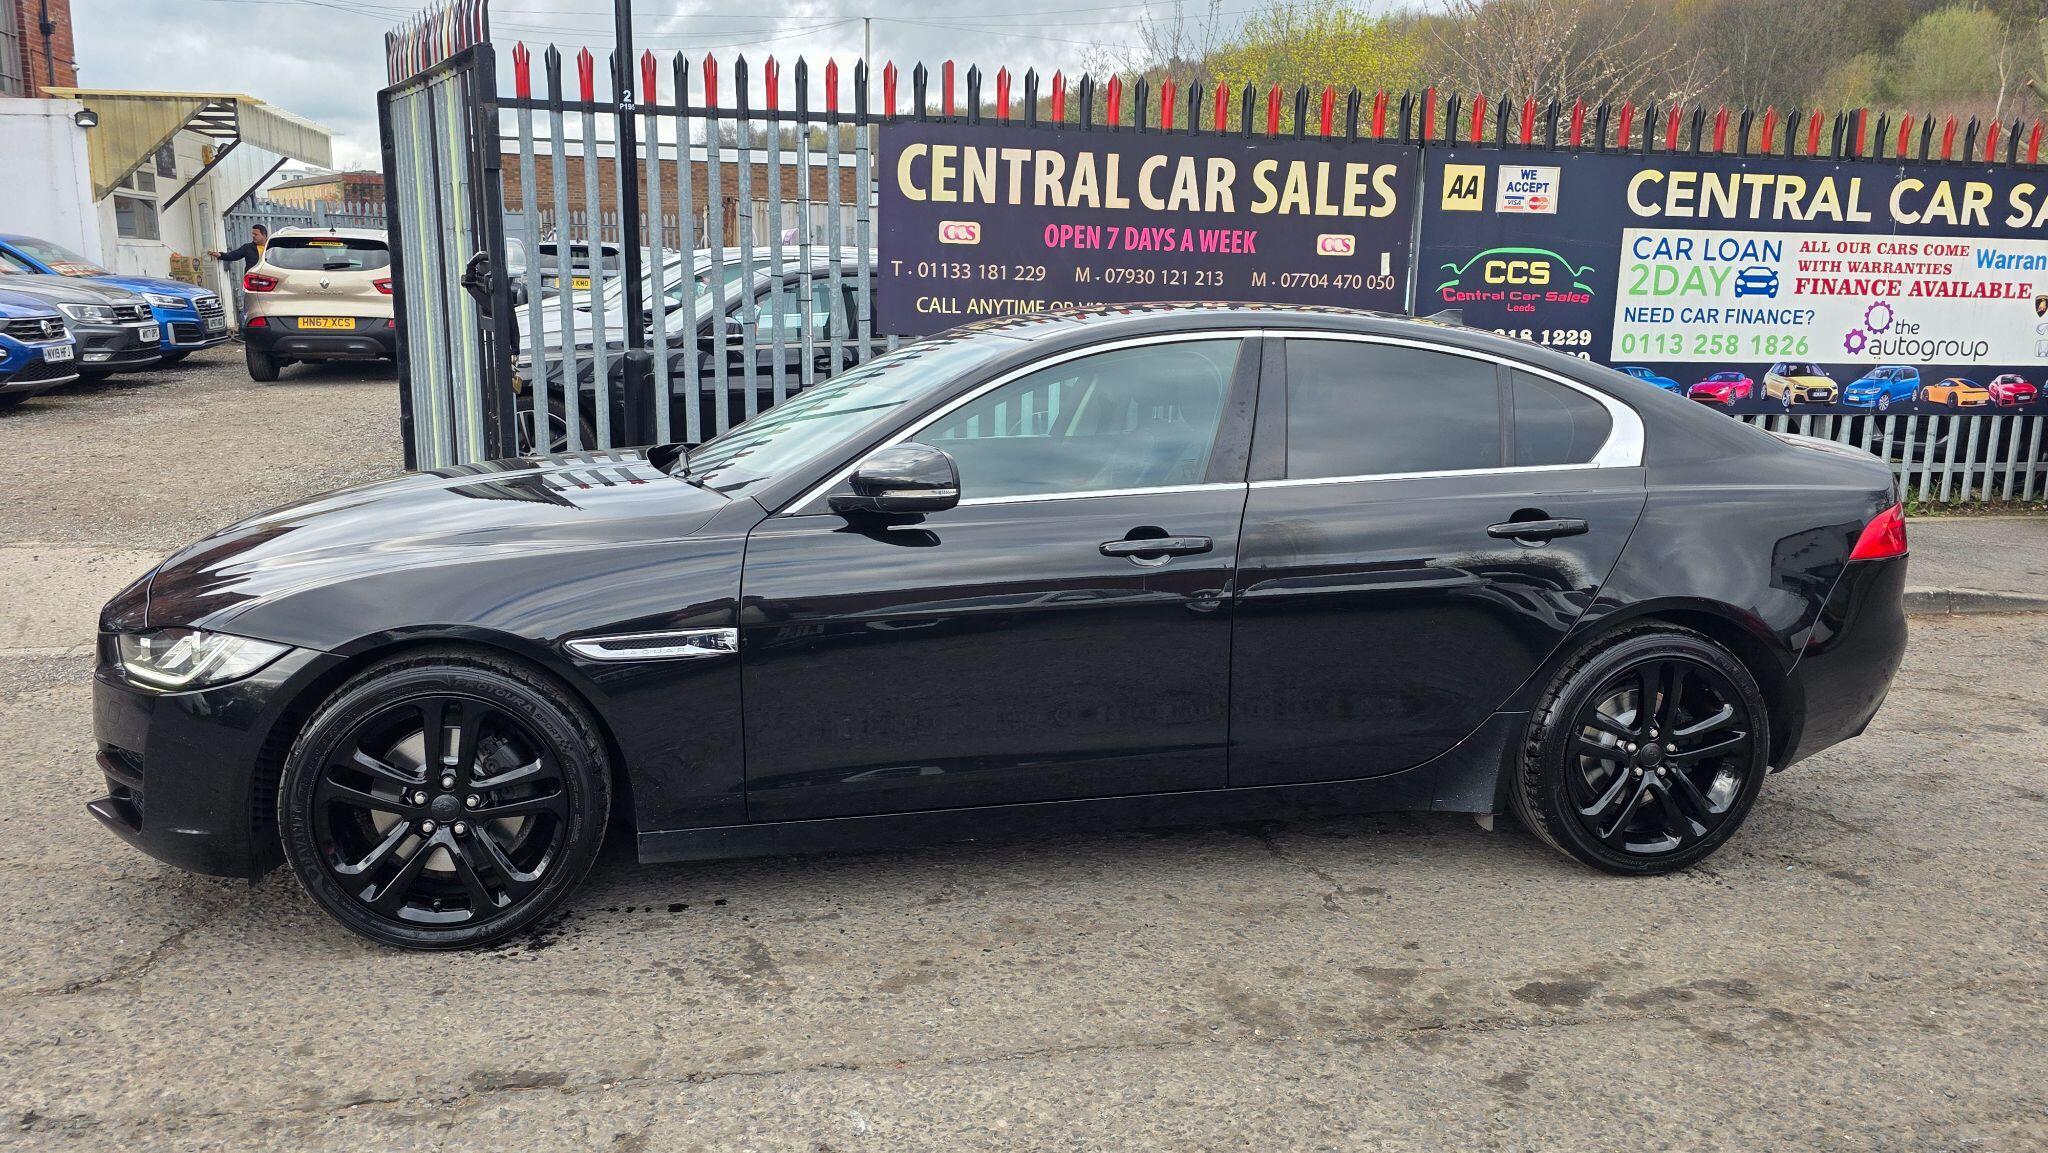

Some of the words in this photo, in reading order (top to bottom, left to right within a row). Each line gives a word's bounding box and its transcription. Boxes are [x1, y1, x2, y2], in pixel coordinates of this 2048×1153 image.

[622, 90, 631, 102] 2
[897, 143, 1130, 209] CENTRAL
[1138, 154, 1236, 213] CAR
[1250, 159, 1397, 218] SALES
[1520, 169, 1538, 180] WE
[1447, 174, 1479, 200] AA
[1506, 182, 1550, 194] ACCEPT
[1627, 169, 1872, 222] CENTRAL
[1889, 178, 1993, 226] CAR
[1044, 224, 1101, 249] OPEN
[1106, 227, 1120, 250] 7
[1124, 226, 1176, 252] DAYS
[1180, 228, 1194, 252] A
[1199, 229, 1257, 254] WEEK
[1632, 236, 1694, 261] CAR
[1704, 238, 1782, 262] LOAN
[1800, 241, 1830, 253] ALL
[1836, 242, 1872, 254] OUR
[1876, 243, 1918, 256] CARS
[1923, 244, 1970, 257] COME
[1798, 260, 1842, 273] WITH
[1848, 261, 1953, 276] WARRANTIES
[1976, 248, 2047, 270] Warran
[918, 262, 971, 279] 01133
[978, 264, 1006, 280] 181
[1014, 265, 1046, 282] 229
[1104, 268, 1155, 284] 07930
[1162, 270, 1187, 286] 121
[1194, 270, 1224, 286] 213
[1280, 272, 1328, 288] 07704
[1332, 274, 1362, 290] 470
[1366, 274, 1395, 290] 050
[1484, 260, 1550, 285] CCS
[1628, 264, 1732, 296] 2DAY
[1442, 288, 1505, 302] Central
[1509, 291, 1542, 301] Car
[1545, 292, 1590, 304] Sales
[1794, 277, 1902, 296] FINANCE
[1908, 280, 2033, 300] AVAILABLE
[916, 296, 962, 314] CALL
[966, 298, 1045, 315] ANYTIME
[1506, 302, 1536, 312] Leeds
[302, 318, 328, 327] HN67
[332, 318, 351, 327] XCS
[1624, 307, 1674, 323] NEED
[1680, 308, 1719, 324] CAR
[1724, 309, 1816, 326] FINANCE?
[1895, 319, 1920, 334] the
[1540, 329, 1592, 346] 1229
[1622, 333, 1684, 354] 0113
[1693, 334, 1740, 355] 258
[1750, 336, 1809, 356] 1826
[1868, 336, 1989, 362] autogroup
